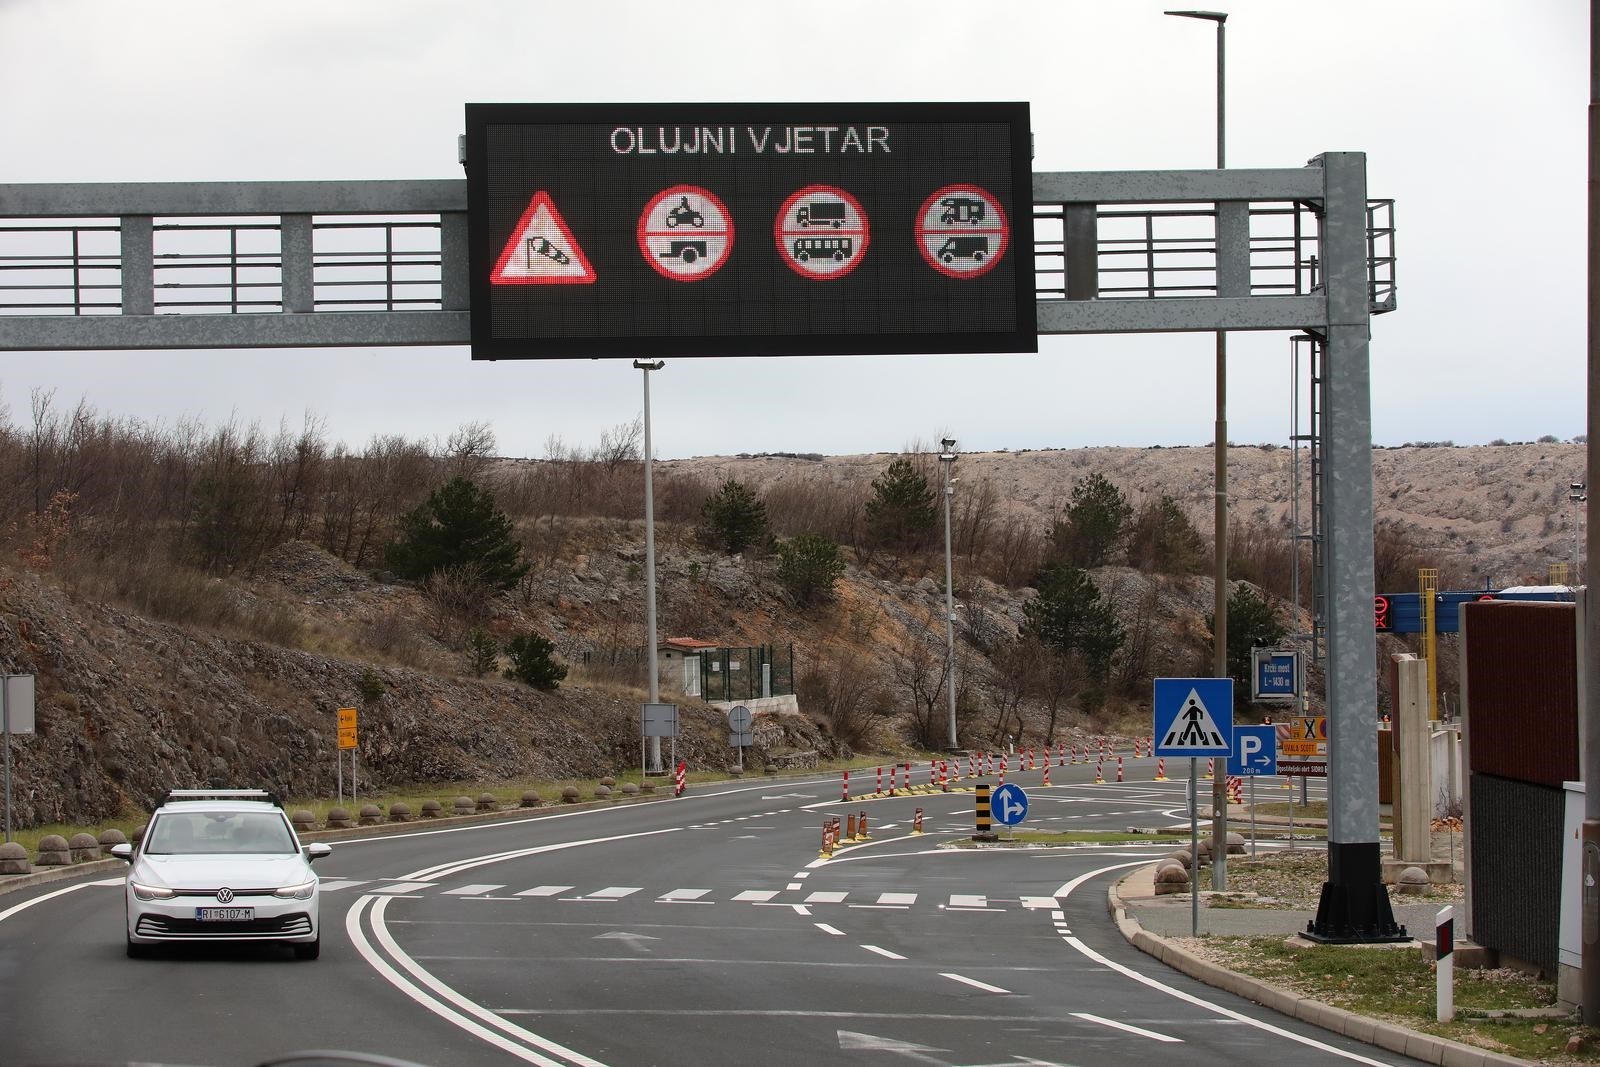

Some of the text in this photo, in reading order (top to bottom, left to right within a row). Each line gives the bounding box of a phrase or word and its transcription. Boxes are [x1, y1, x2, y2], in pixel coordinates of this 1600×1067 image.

[610, 125, 892, 154] OLUJNI VJETAR
[1240, 735, 1262, 767] P
[203, 909, 213, 919] RI
